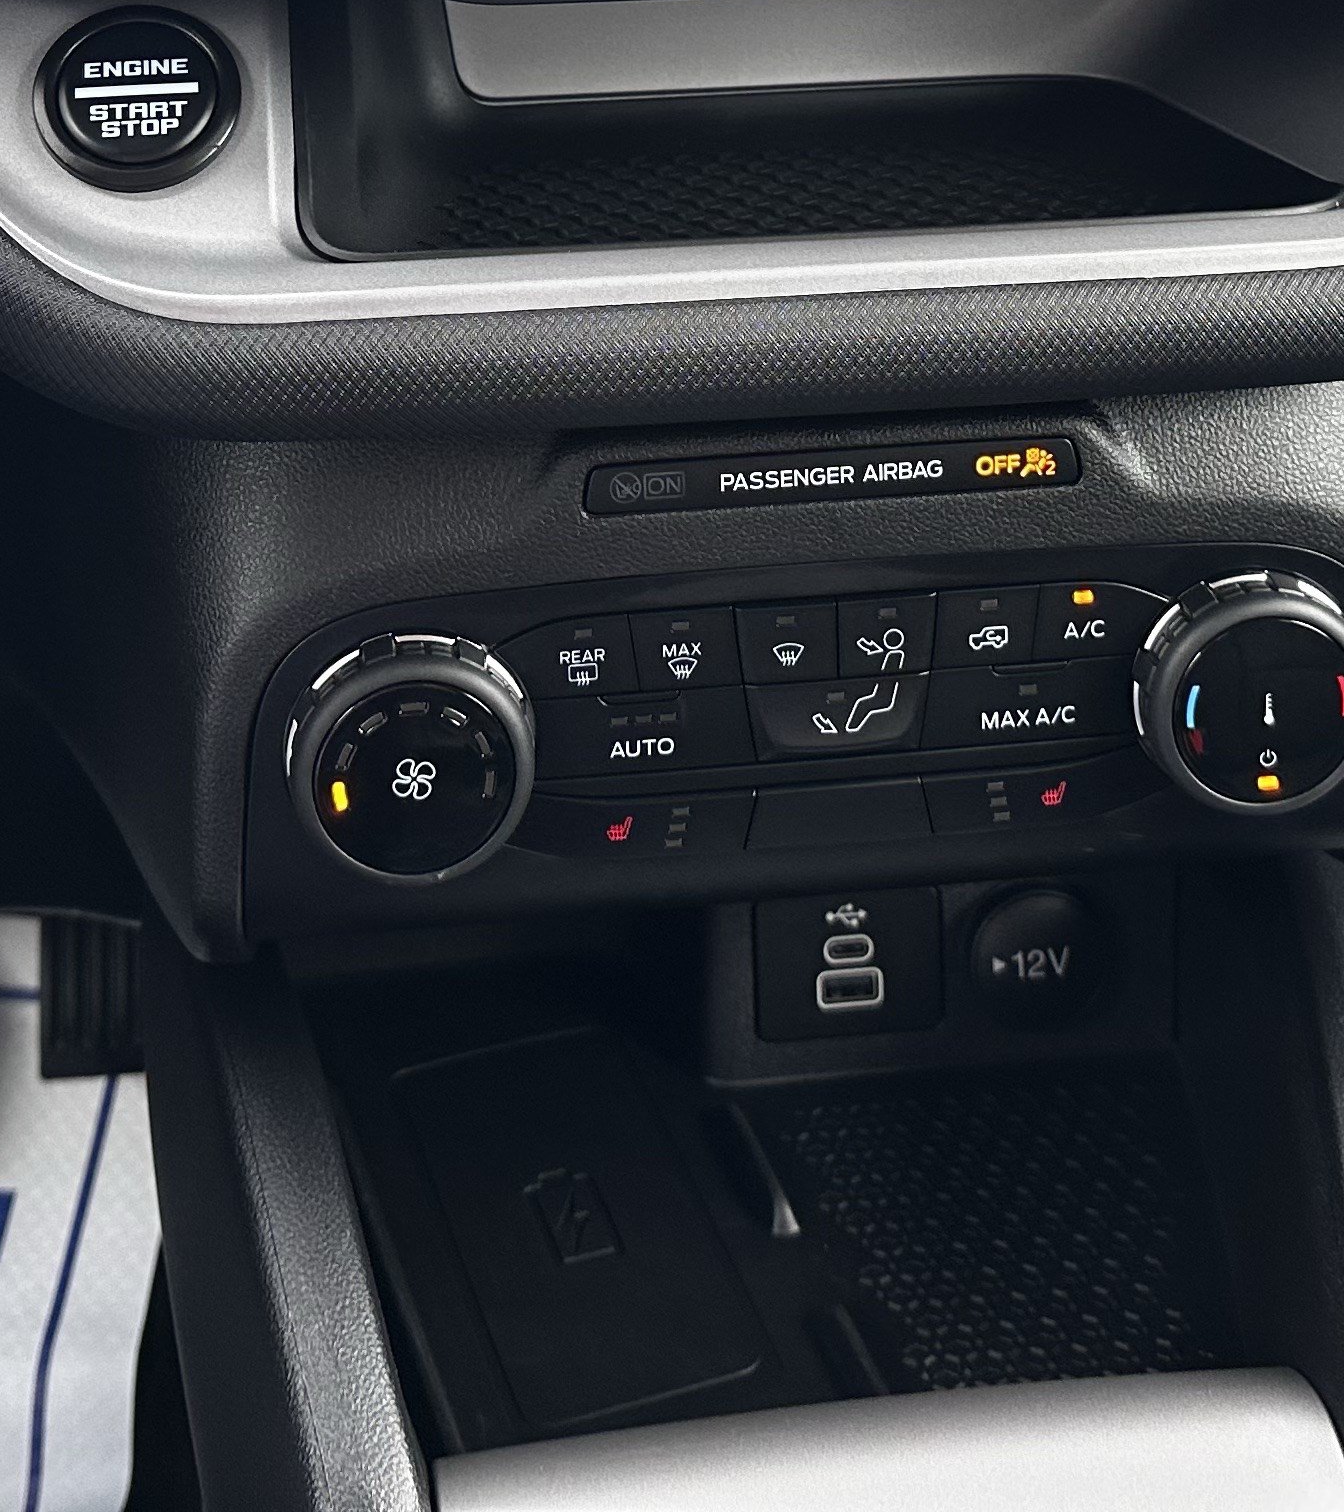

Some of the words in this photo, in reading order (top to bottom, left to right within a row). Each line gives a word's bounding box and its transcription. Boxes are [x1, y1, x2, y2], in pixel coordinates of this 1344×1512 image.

[83, 58, 189, 79] ENGINE
[89, 100, 188, 122] START
[101, 117, 180, 138] STOP
[975, 453, 1022, 477] OFF
[719, 466, 855, 493] PASSENGER
[862, 459, 945, 483] AIRBAG
[1063, 620, 1107, 640] A/C
[559, 647, 606, 666] REAR
[662, 641, 703, 658] MAX
[980, 708, 1030, 731] MAX
[1036, 705, 1076, 725] A/C
[609, 737, 675, 758] AUTO
[1010, 945, 1071, 981] 12V
